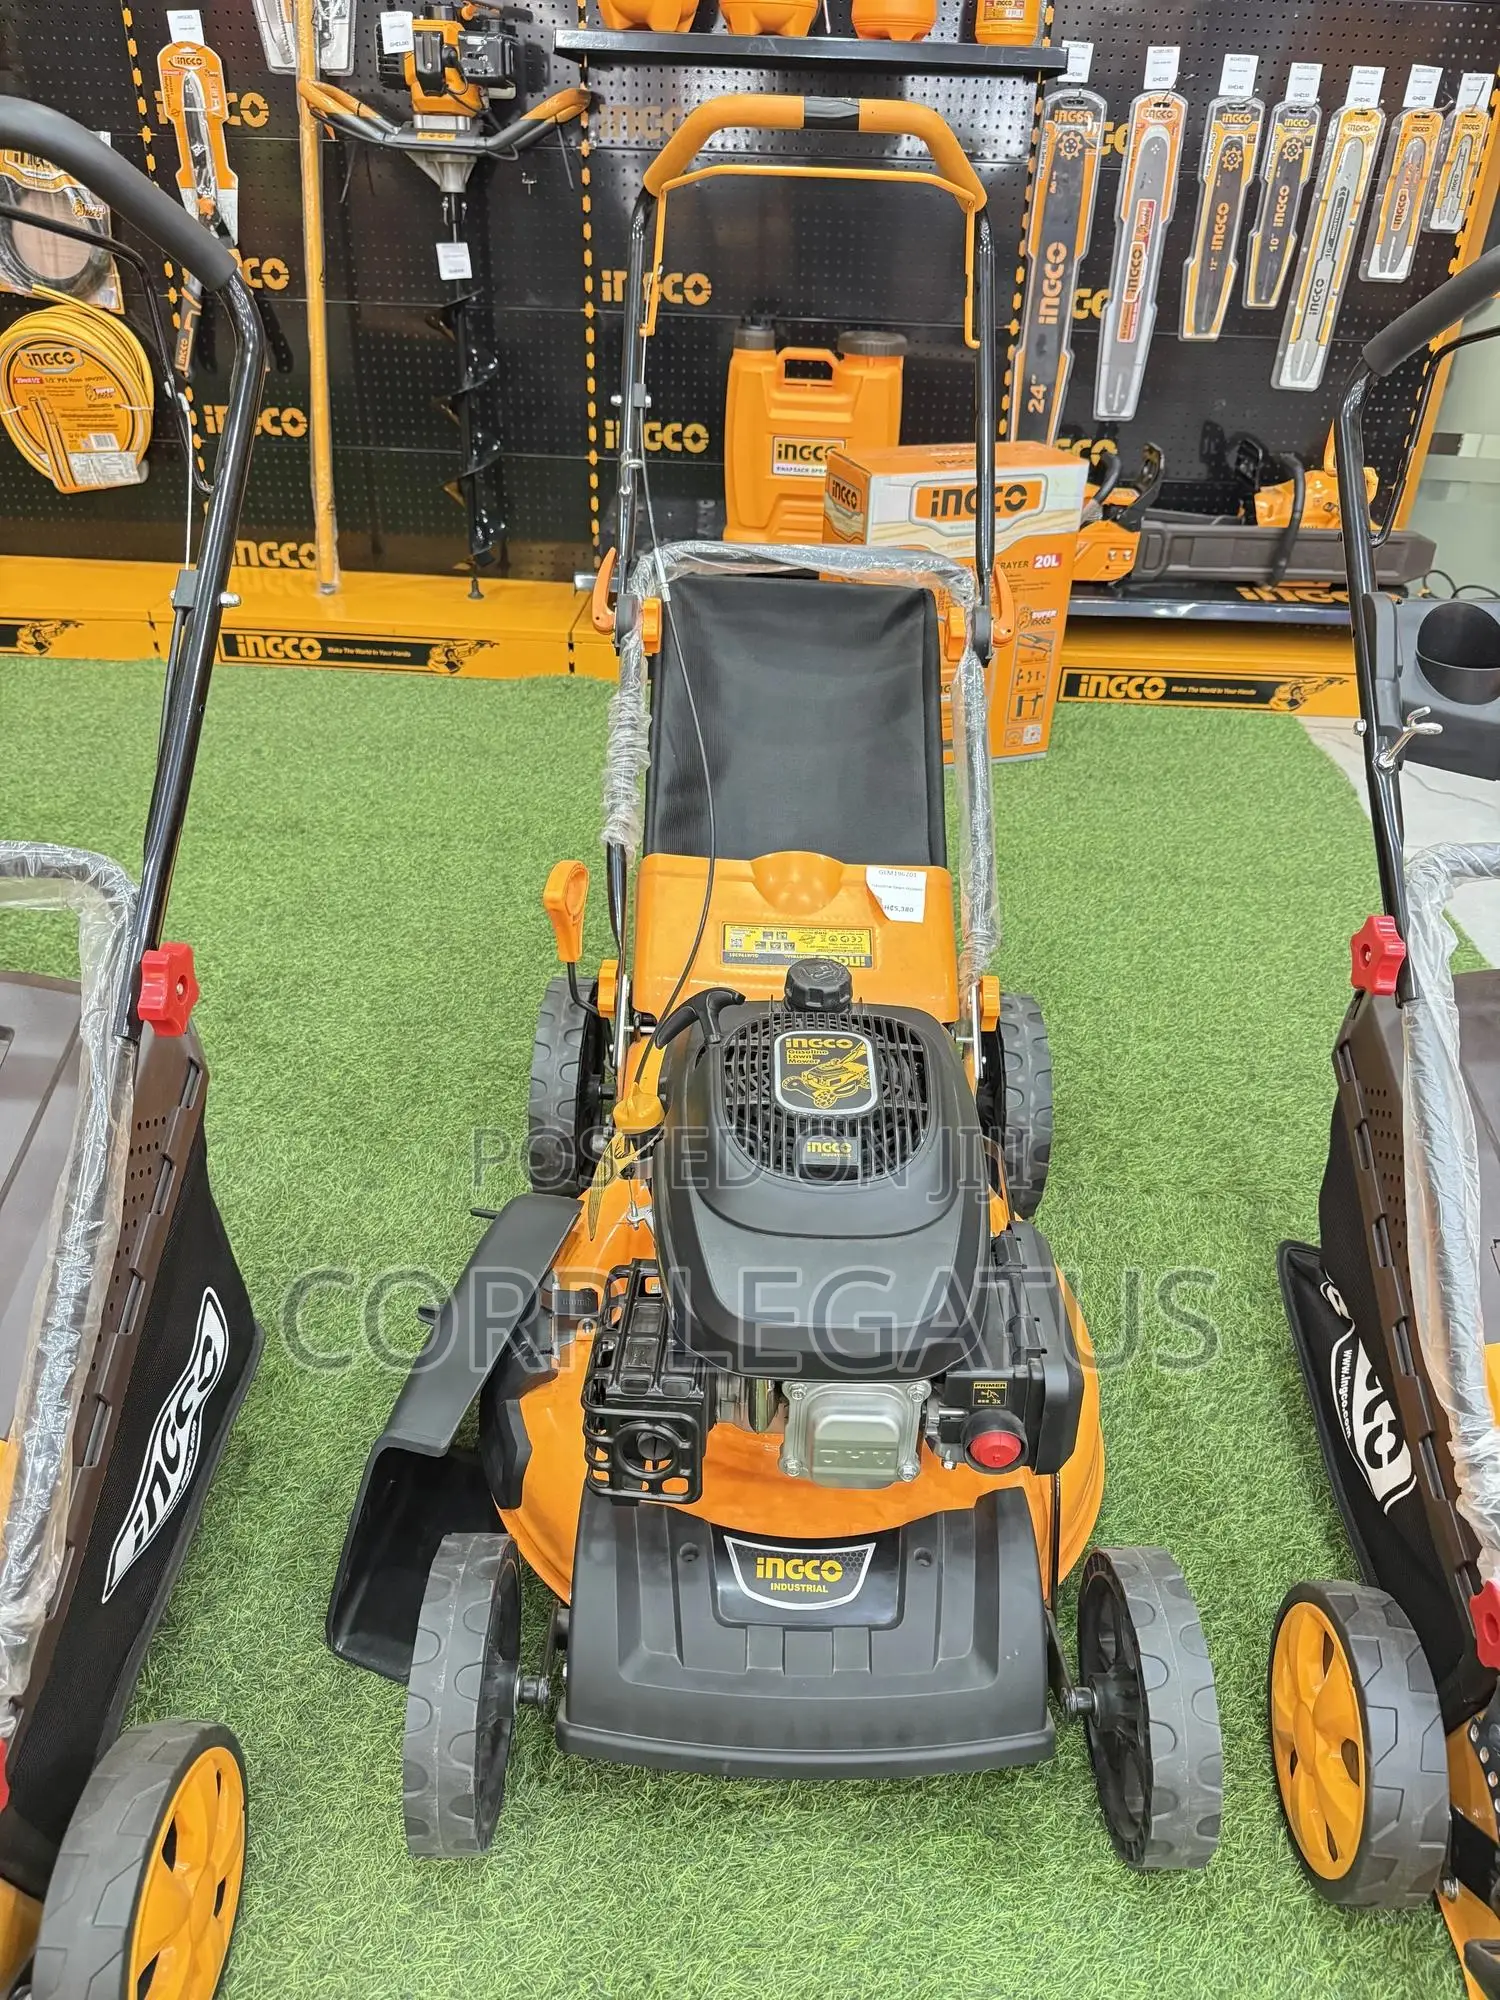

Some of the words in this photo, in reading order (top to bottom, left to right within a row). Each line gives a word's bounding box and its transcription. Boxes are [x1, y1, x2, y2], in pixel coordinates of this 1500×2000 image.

[1273, 185, 1291, 228] INGCO
[1393, 193, 1407, 226] INGCO
[1211, 202, 1230, 252] INGCO
[1038, 241, 1068, 325] INGCO
[1127, 249, 1143, 294] INGCO
[1309, 278, 1325, 316] INGCO
[27, 351, 76, 366] INGCO
[832, 479, 857, 510] INGCO
[1034, 554, 1060, 569] 20L
[236, 634, 322, 661] INGCO
[1079, 674, 1167, 700] INGCO
[785, 1037, 853, 1049] INGCO
[806, 1141, 852, 1153] INGCO
[755, 1557, 843, 1583] INGCO
[770, 1582, 829, 1593] INDUSTRIAL
